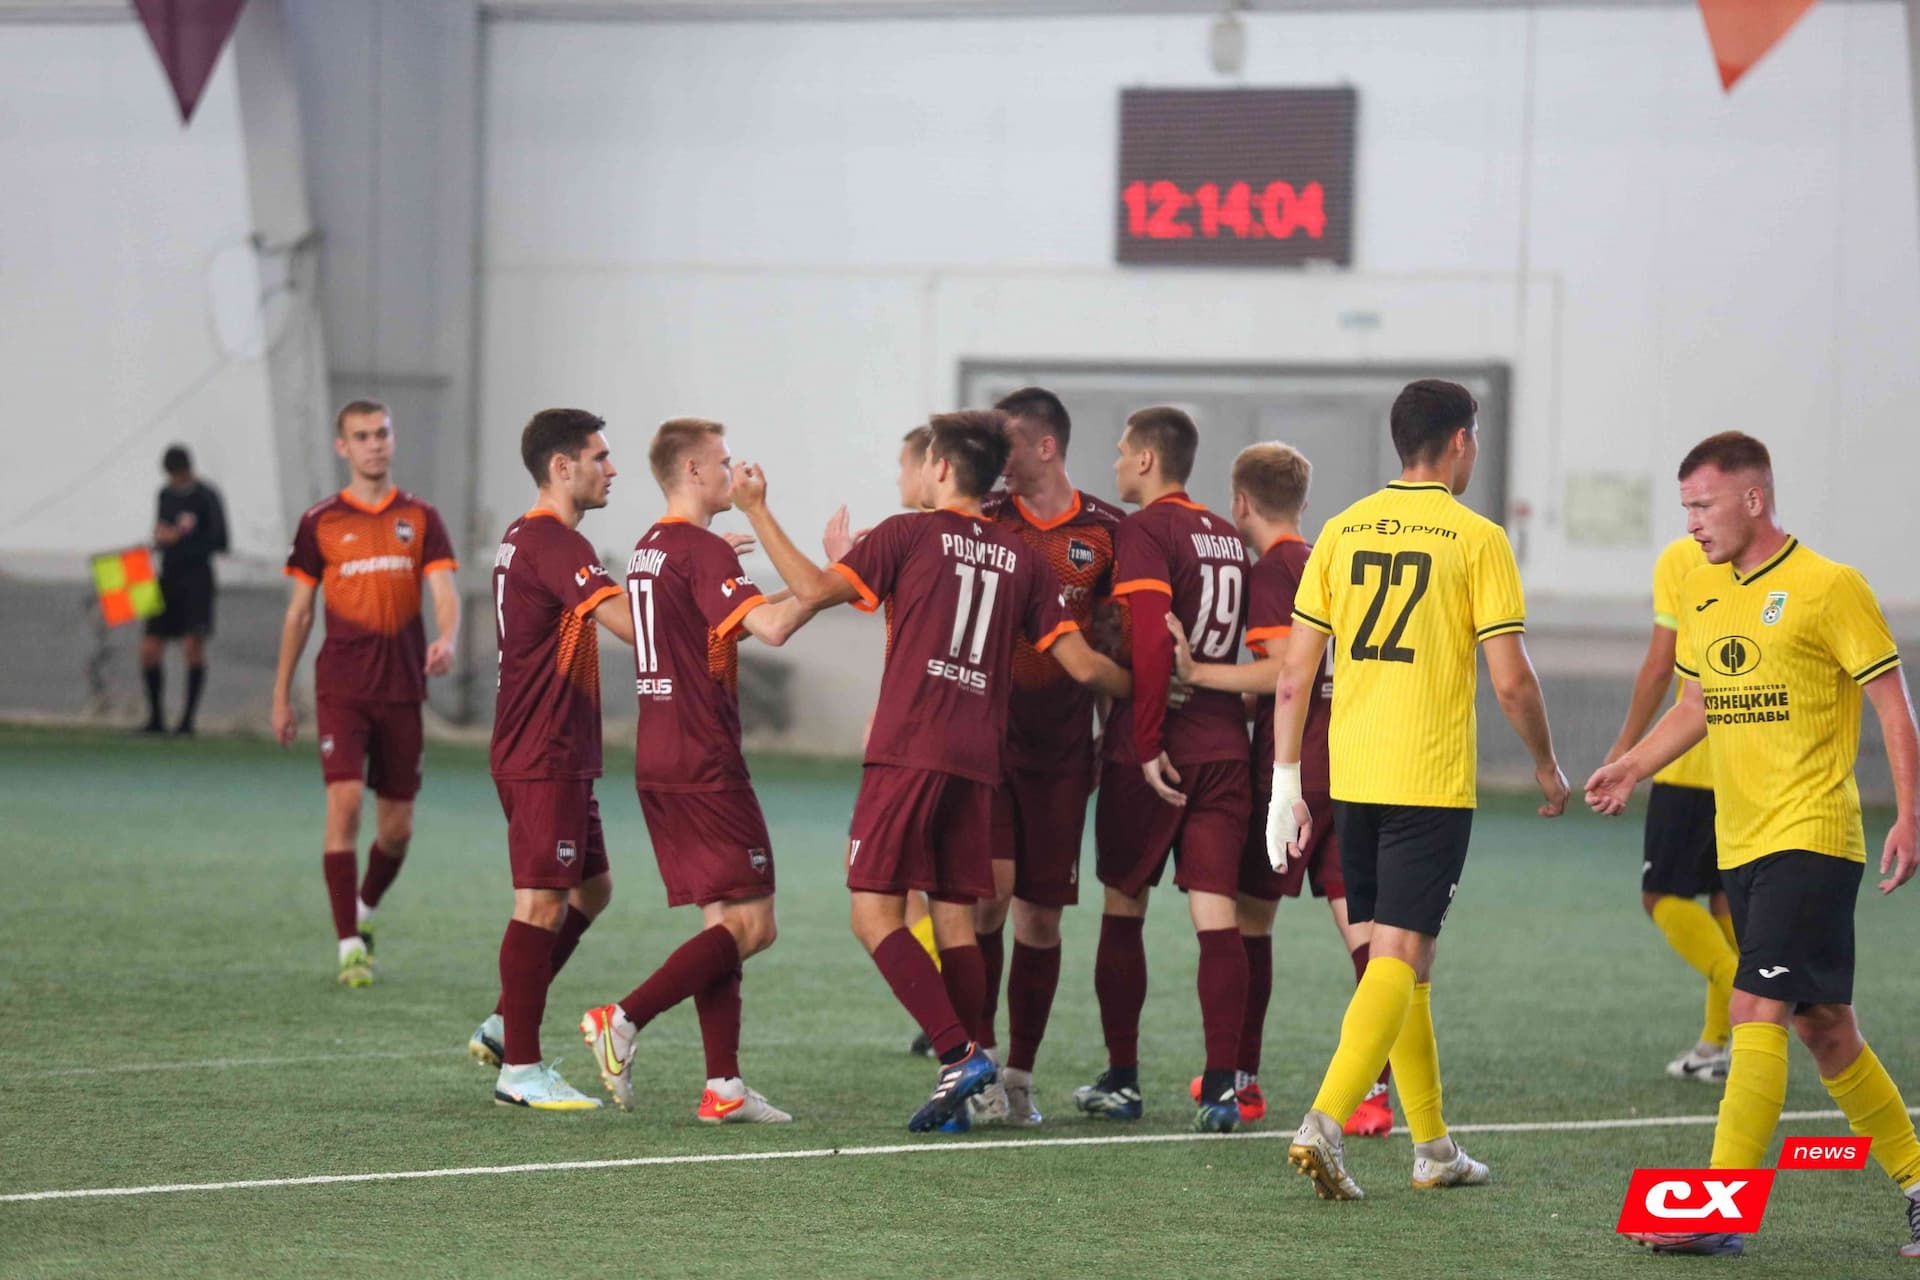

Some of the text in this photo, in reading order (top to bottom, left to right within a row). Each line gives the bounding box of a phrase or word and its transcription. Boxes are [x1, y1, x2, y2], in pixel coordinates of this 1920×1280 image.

[1123, 181, 1326, 239] 12:14:04
[941, 533, 1017, 574] РОДИЧЕВ
[1191, 533, 1244, 561] ШИБАЕВ
[1403, 525, 1457, 540] ГРУПП
[950, 563, 999, 664] 11
[1189, 564, 1242, 658] 19
[1351, 550, 1432, 664] 22
[927, 659, 987, 689] SEUS
